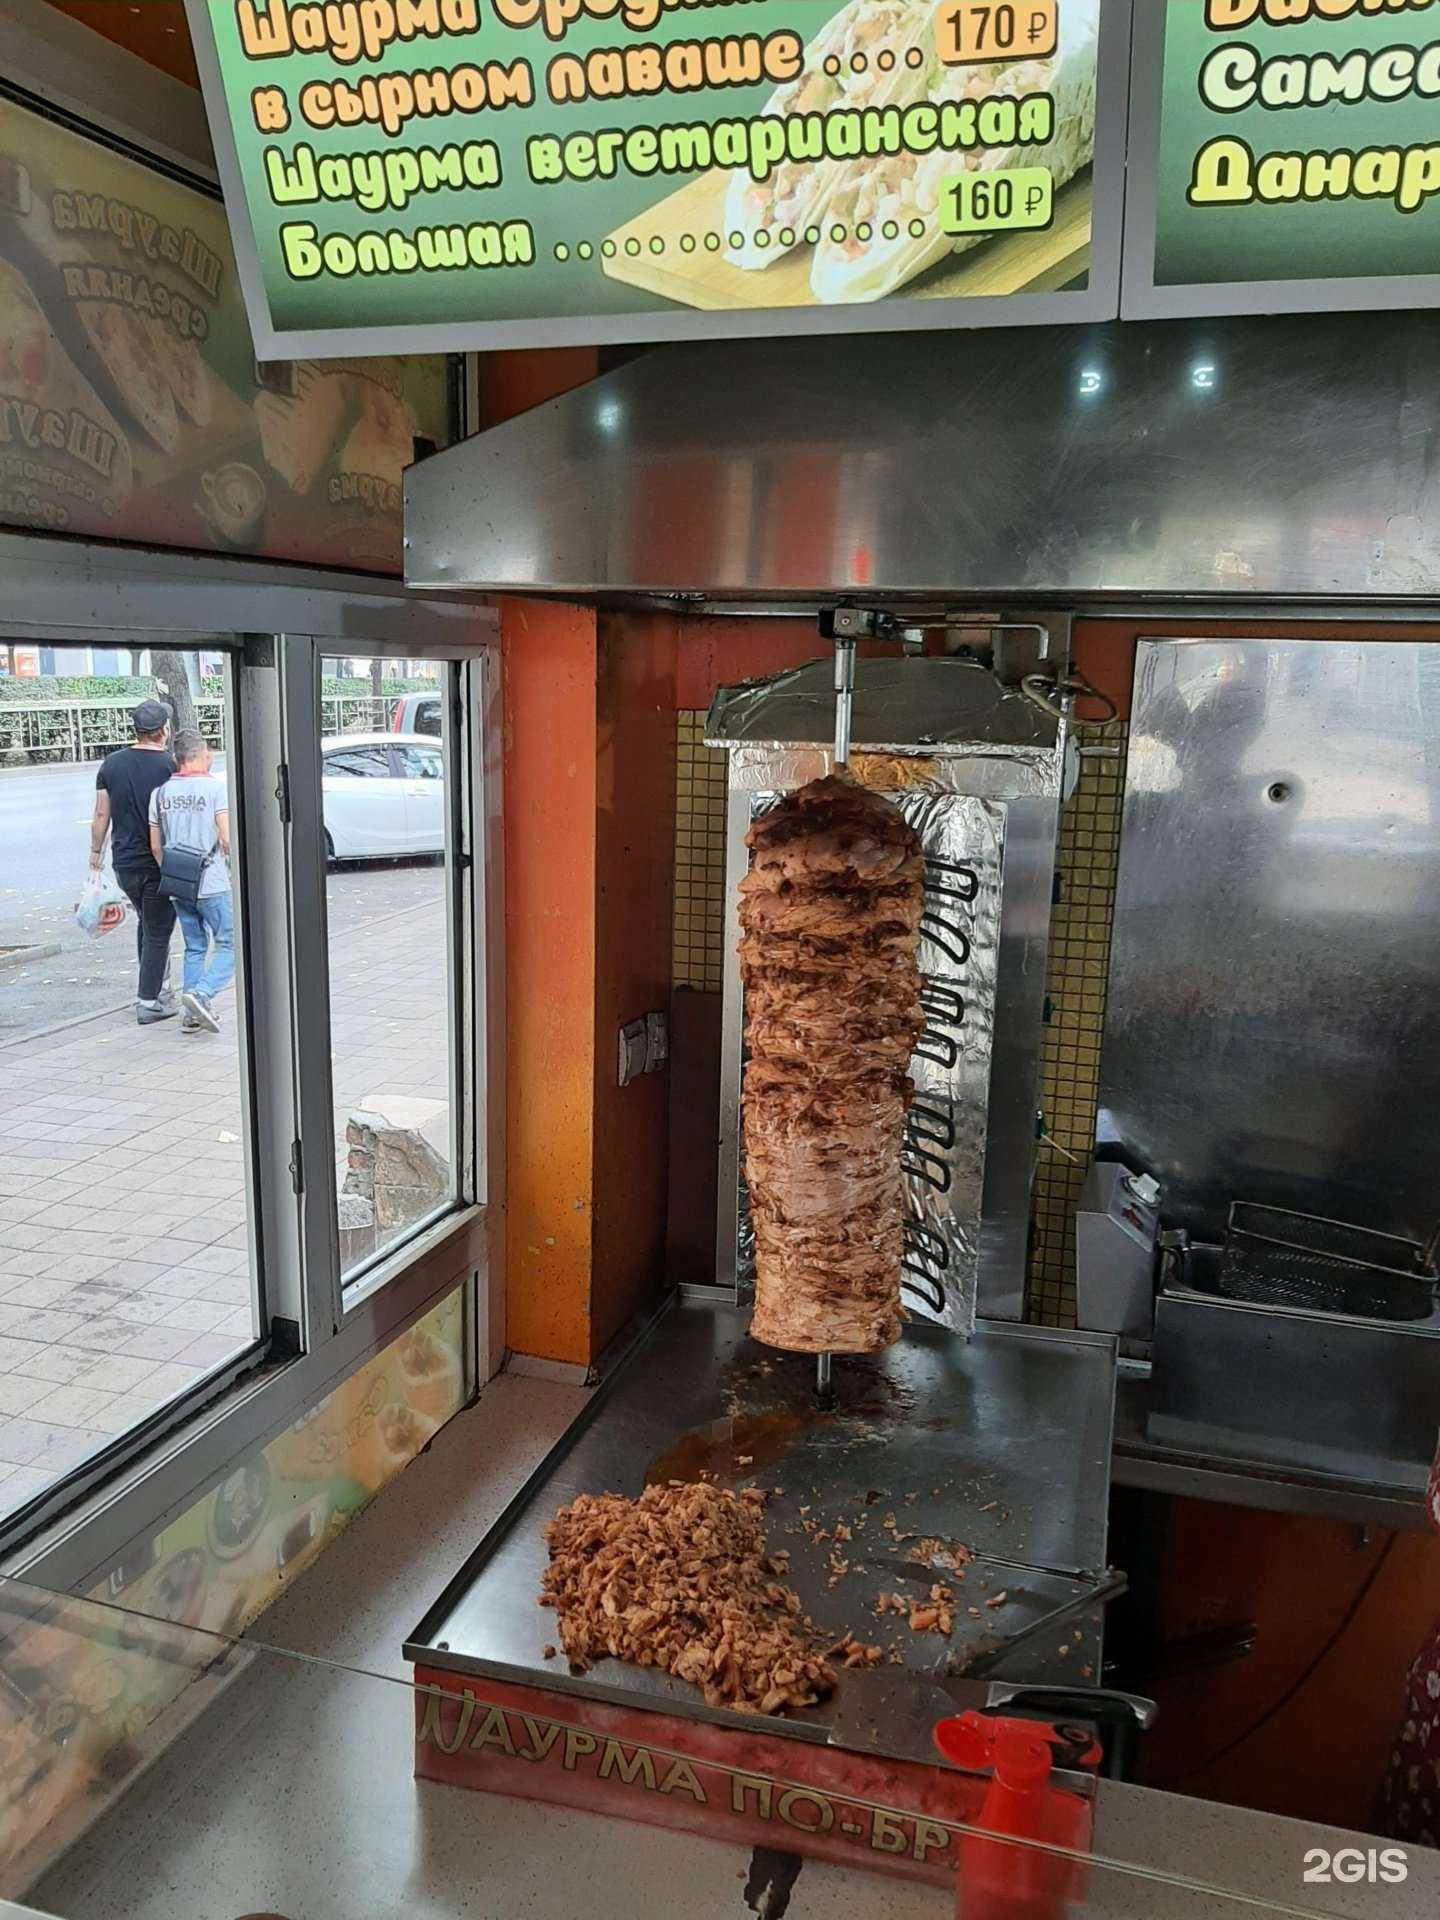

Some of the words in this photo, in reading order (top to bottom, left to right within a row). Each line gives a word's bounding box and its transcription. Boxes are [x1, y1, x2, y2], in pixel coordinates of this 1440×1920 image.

[236, 0, 481, 63] Шаурма
[946, 5, 1015, 52] 170
[251, 84, 291, 134] в
[299, 57, 536, 137] сырном
[548, 28, 804, 104] лаваше
[263, 139, 503, 213] Шаурма
[526, 92, 1054, 184] вегетарианская
[948, 178, 1012, 222] 160
[280, 219, 536, 281] Большая
[731, 1772, 960, 1872] ПО-БР
